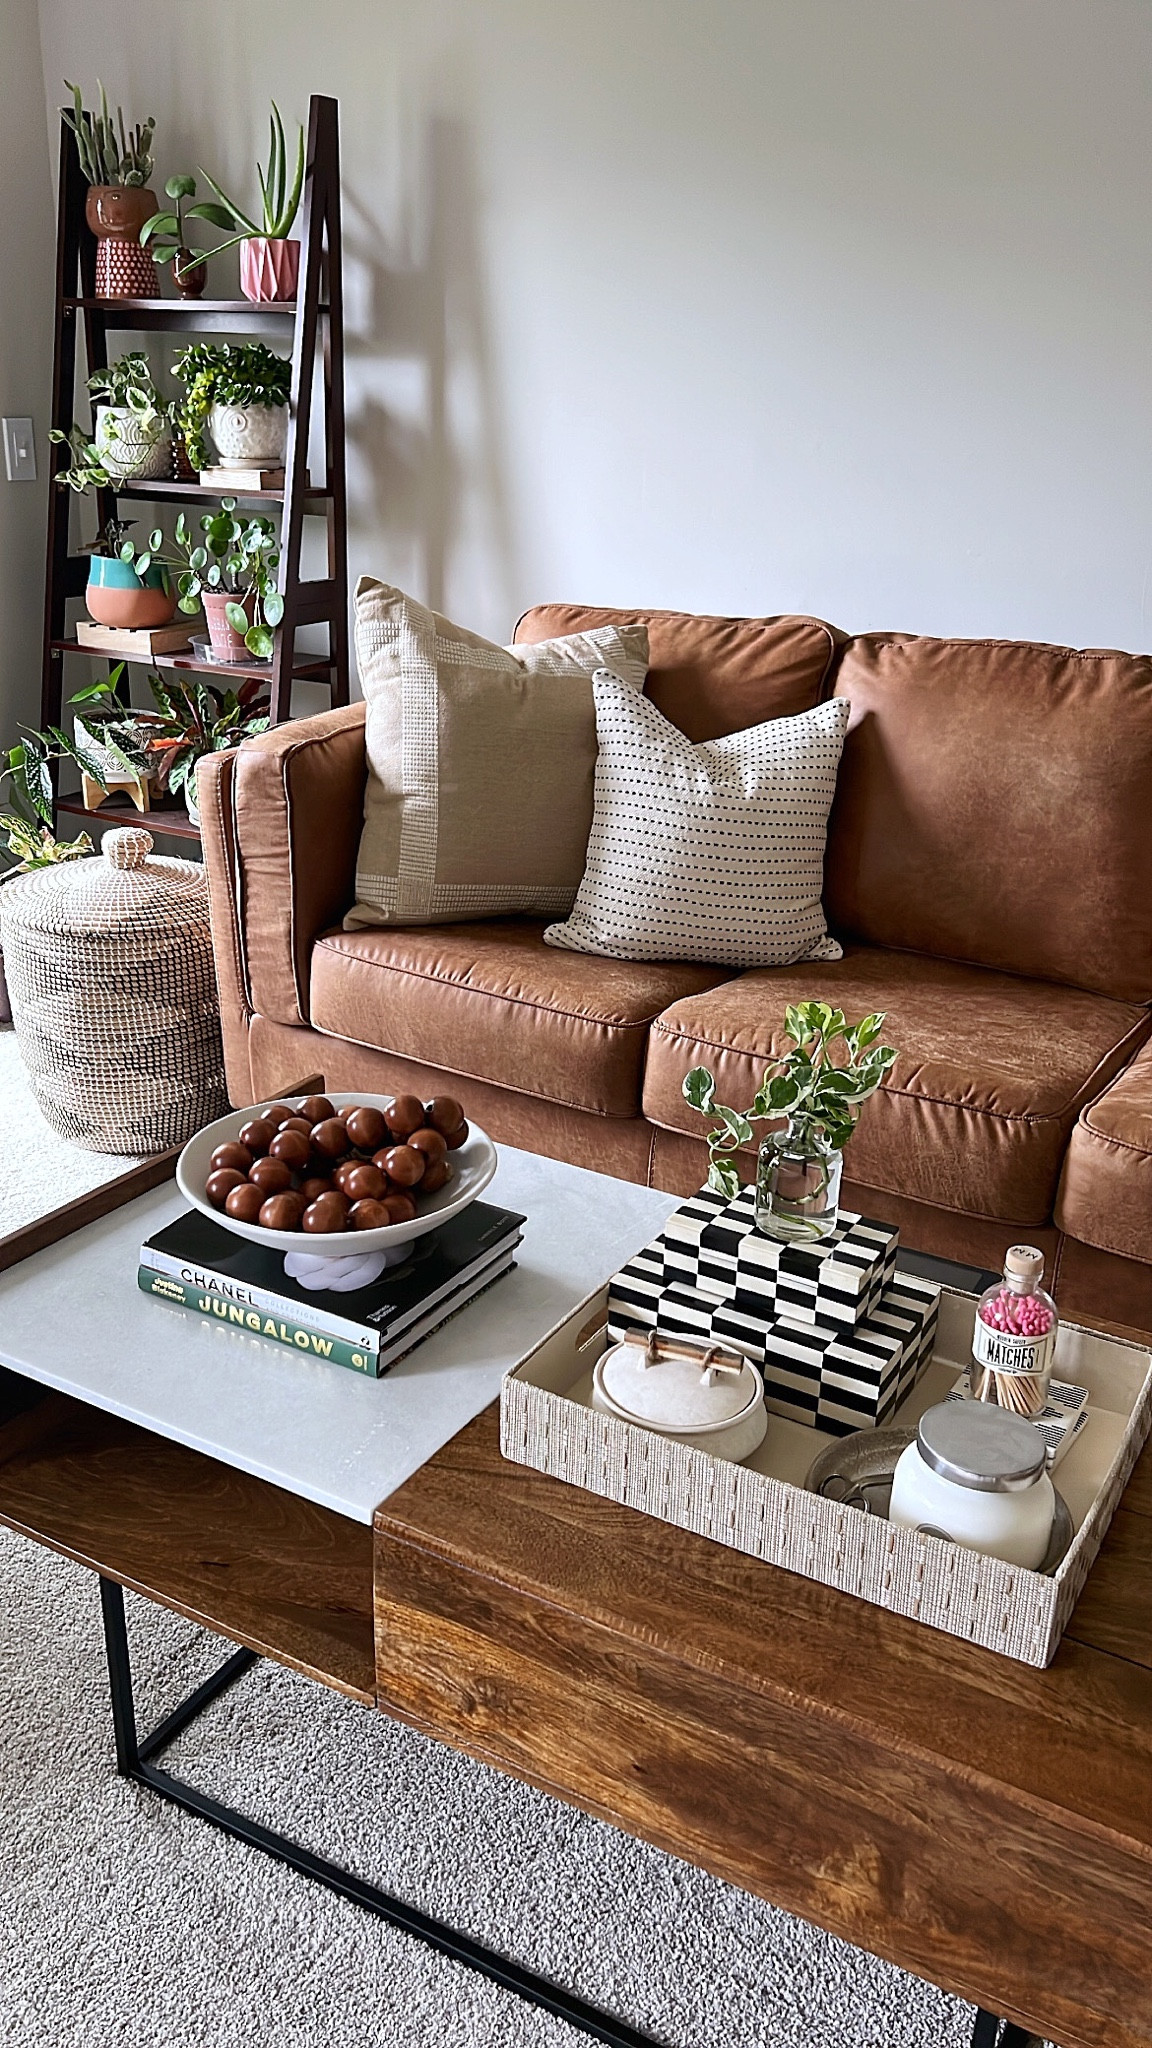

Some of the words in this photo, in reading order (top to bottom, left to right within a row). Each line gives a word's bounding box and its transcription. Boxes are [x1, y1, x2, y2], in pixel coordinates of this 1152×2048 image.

[181, 1268, 260, 1307] CHANEL
[198, 1295, 334, 1357] JUNGALOW
[986, 1338, 1035, 1369] MATCHES
